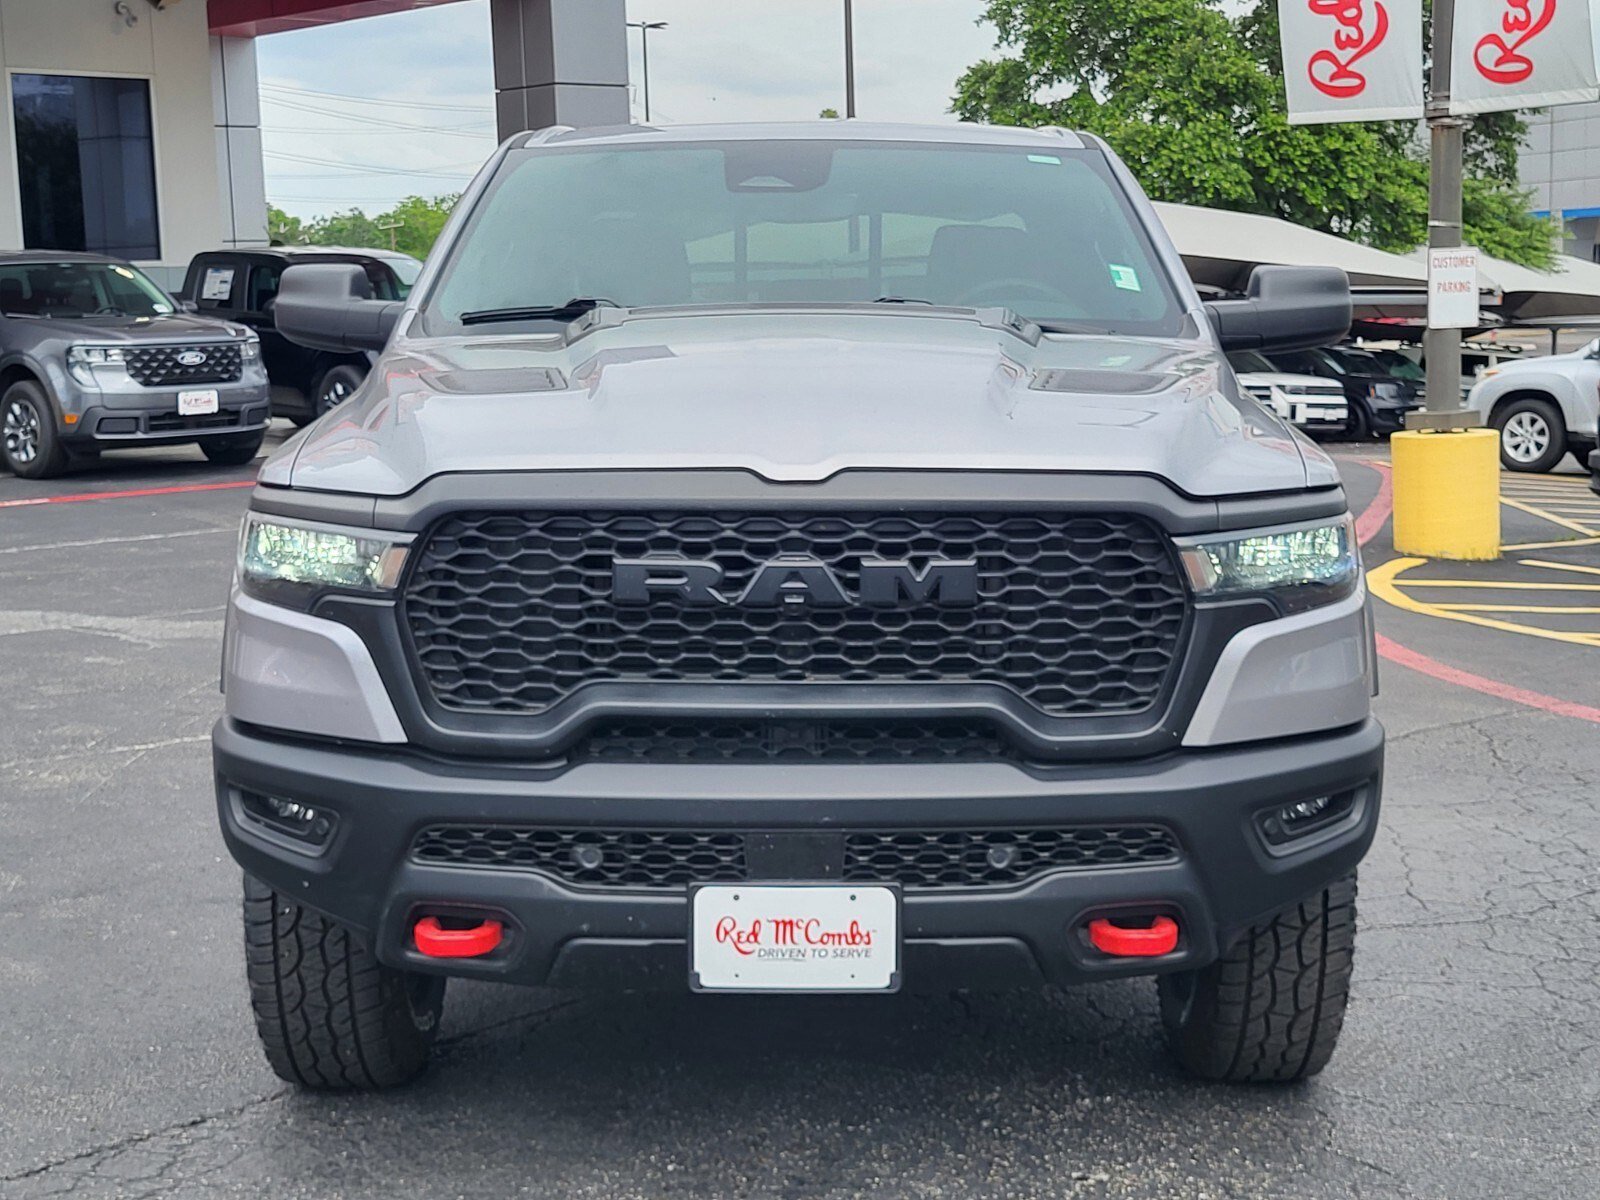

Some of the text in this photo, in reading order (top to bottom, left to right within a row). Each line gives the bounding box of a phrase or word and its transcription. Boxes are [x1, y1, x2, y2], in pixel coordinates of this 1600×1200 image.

[1474, 0, 1556, 84] Re
[1432, 256, 1475, 269] CUSTOMER
[1437, 281, 1471, 293] PARKING
[612, 558, 978, 605] RAM
[715, 915, 872, 956] Red McCombs
[757, 947, 872, 959] DRIVEN TO SERVE
